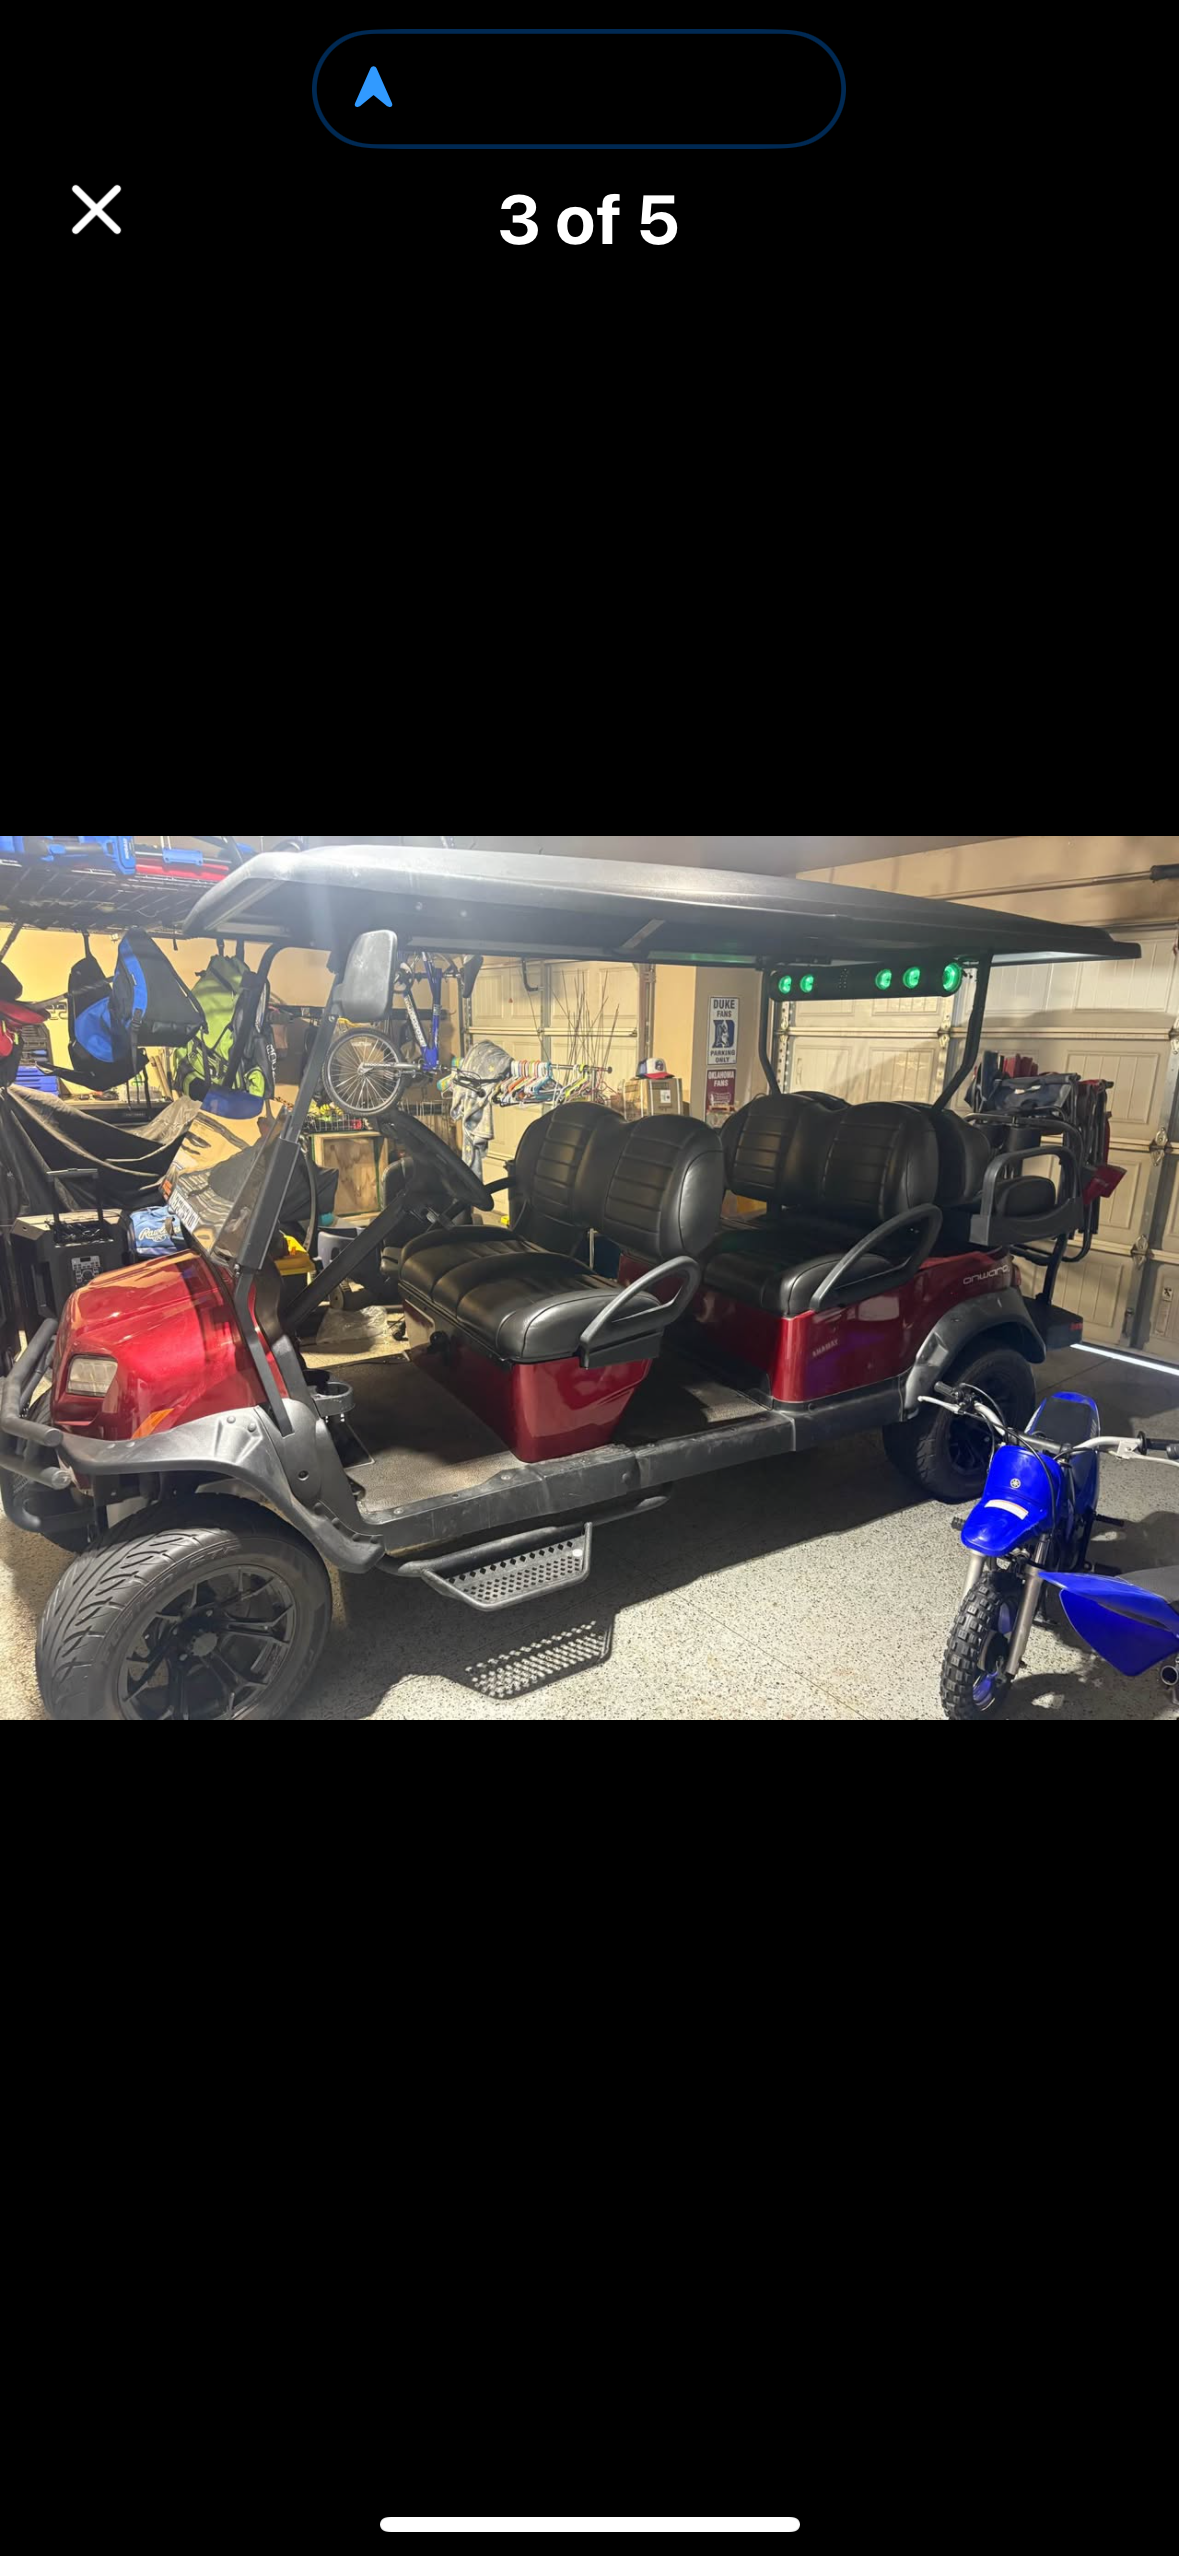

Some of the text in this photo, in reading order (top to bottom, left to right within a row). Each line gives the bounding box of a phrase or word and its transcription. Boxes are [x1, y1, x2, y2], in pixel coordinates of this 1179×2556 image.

[713, 1000, 735, 1009] DUKE
[708, 1071, 734, 1079] OKLAHOMA
[713, 1079, 729, 1087] FANS
